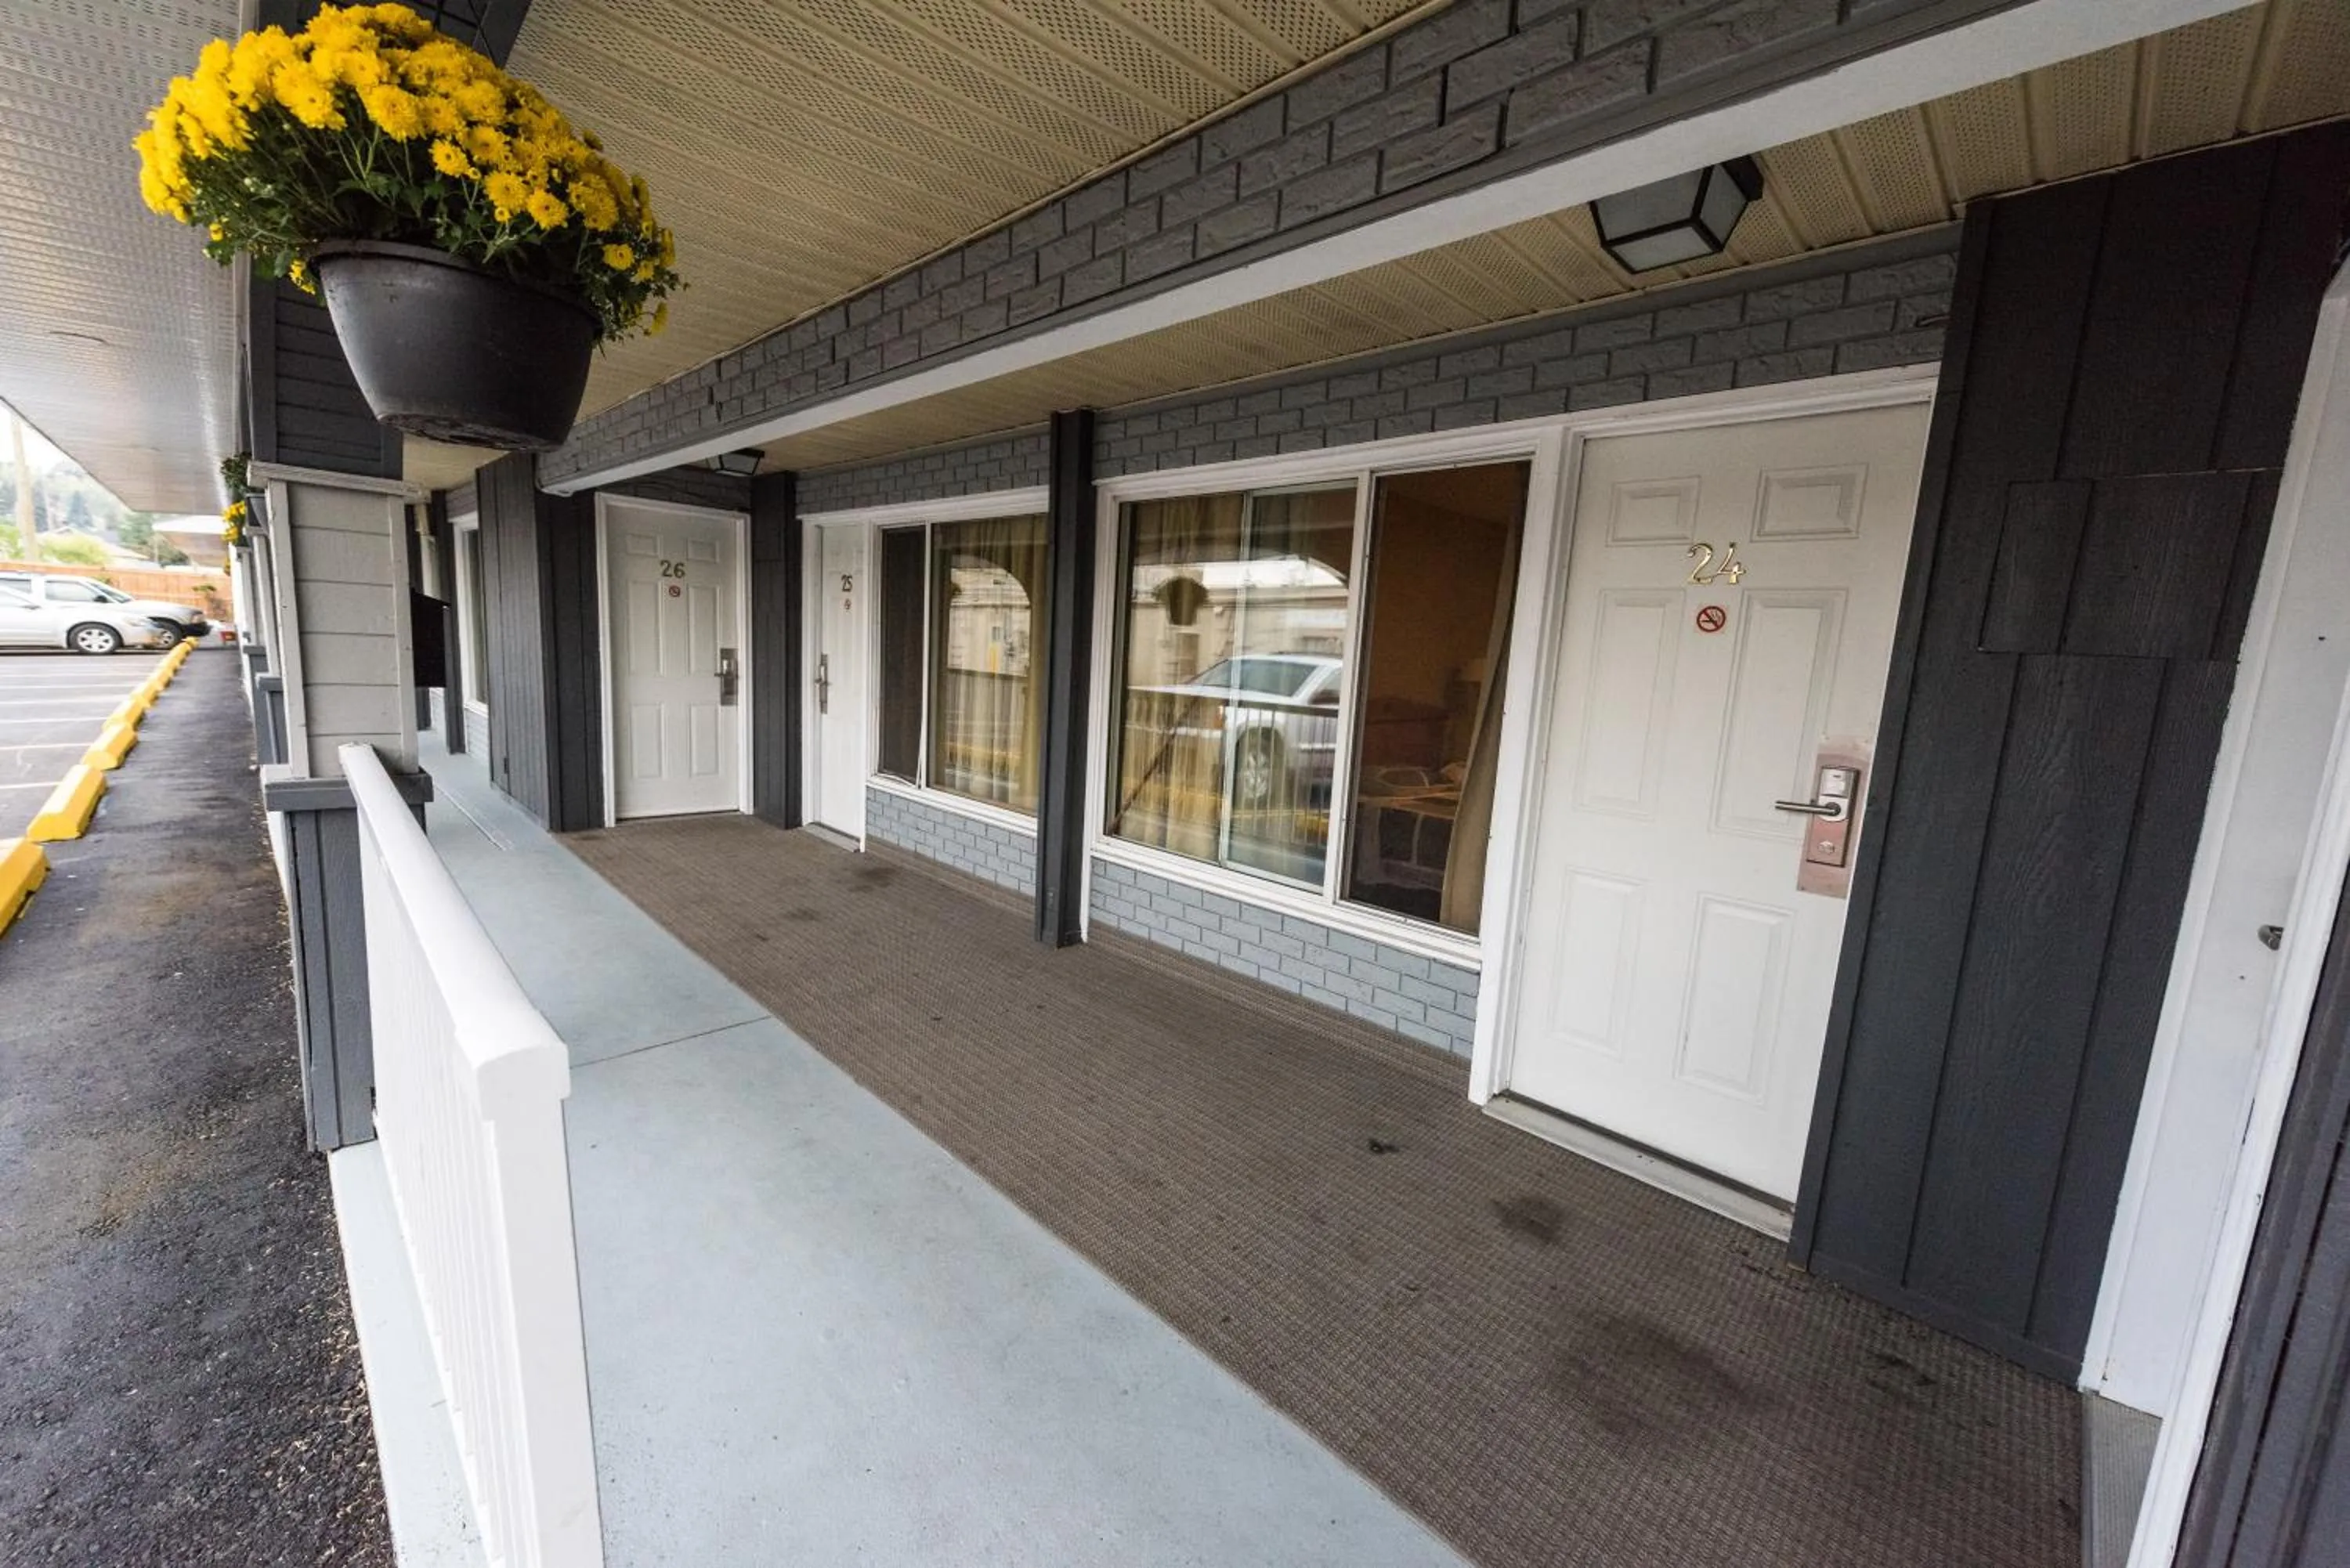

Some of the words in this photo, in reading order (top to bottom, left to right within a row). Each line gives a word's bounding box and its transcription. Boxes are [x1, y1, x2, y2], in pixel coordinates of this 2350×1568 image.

[660, 559, 686, 578] 26
[1686, 541, 1747, 585] 24
[841, 574, 853, 592] 25
